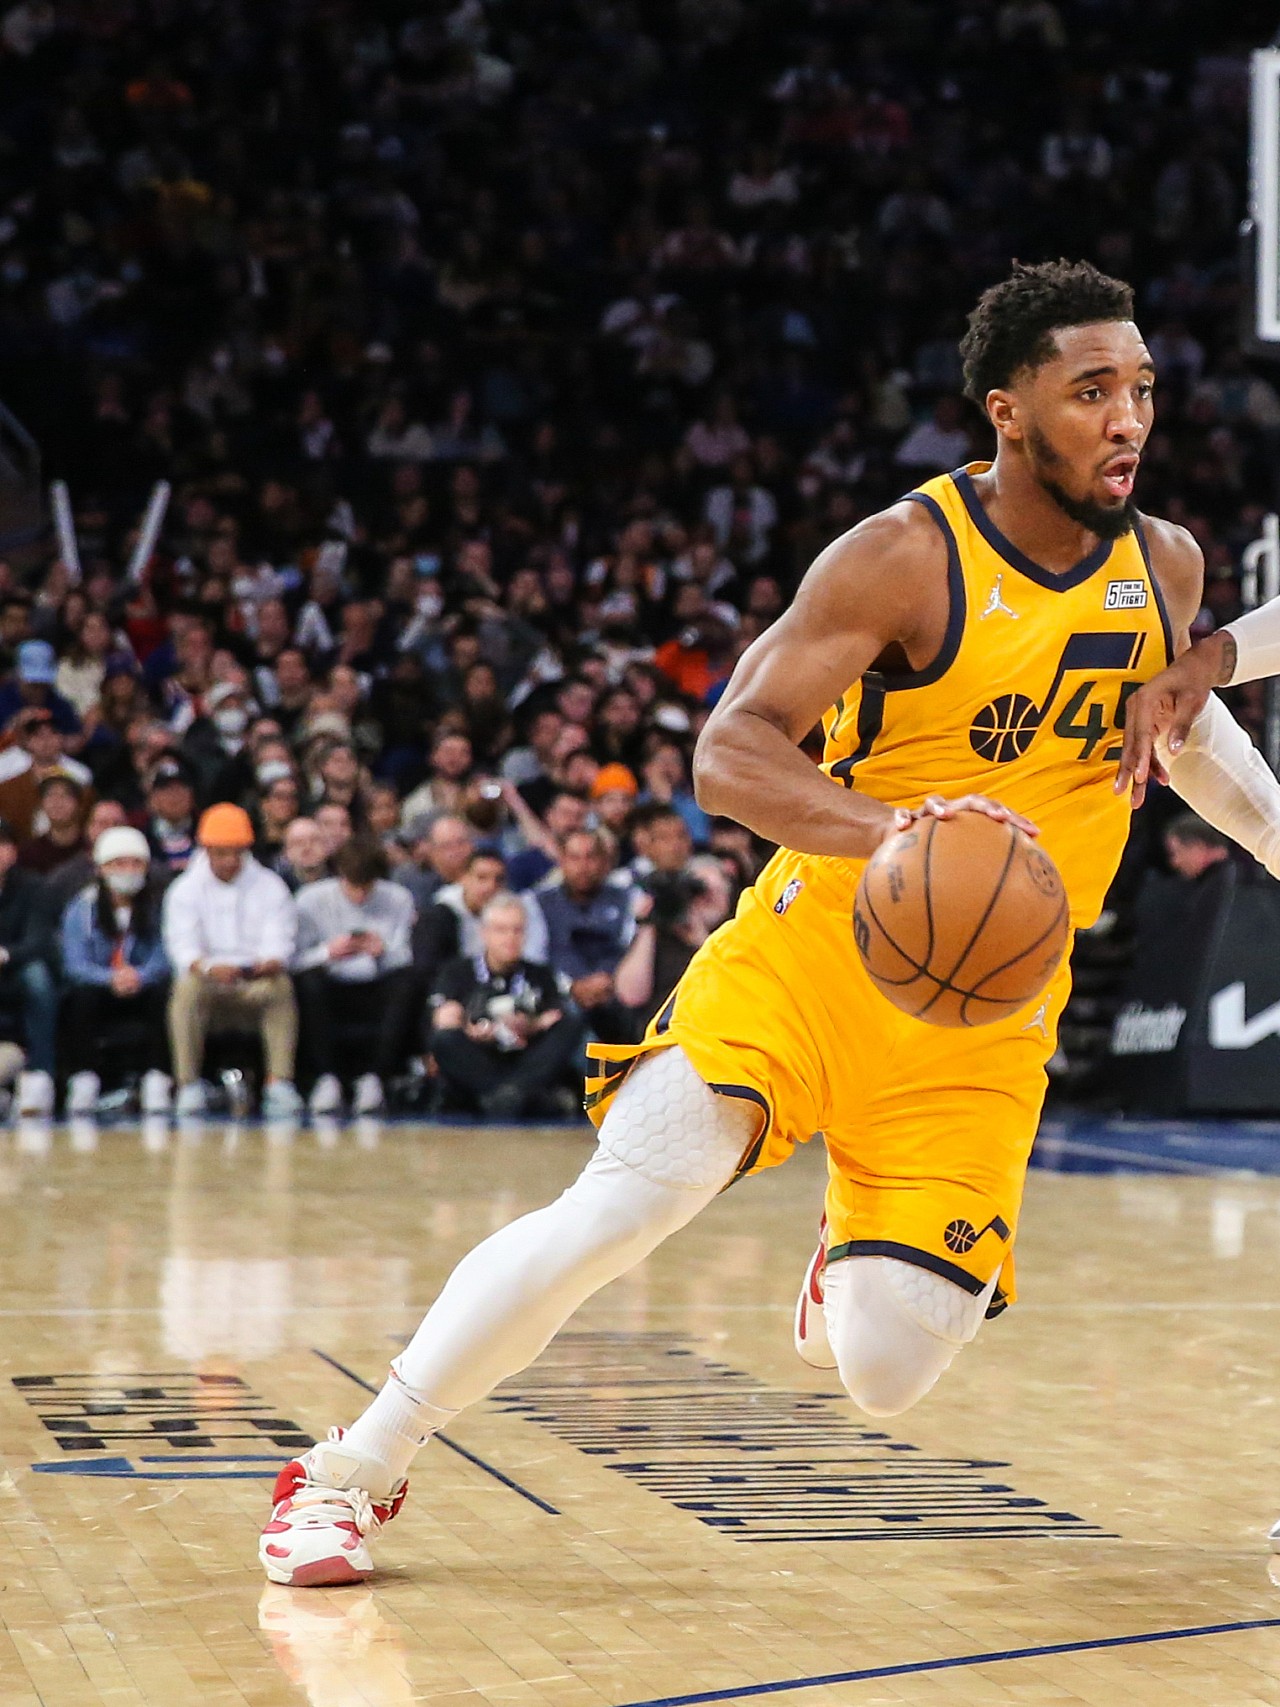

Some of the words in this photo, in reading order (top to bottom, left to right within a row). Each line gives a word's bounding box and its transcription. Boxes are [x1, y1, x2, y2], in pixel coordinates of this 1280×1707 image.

[1108, 584, 1119, 606] 5
[1121, 594, 1145, 605] FIGHT
[602, 1457, 1122, 1543] GARDEN
